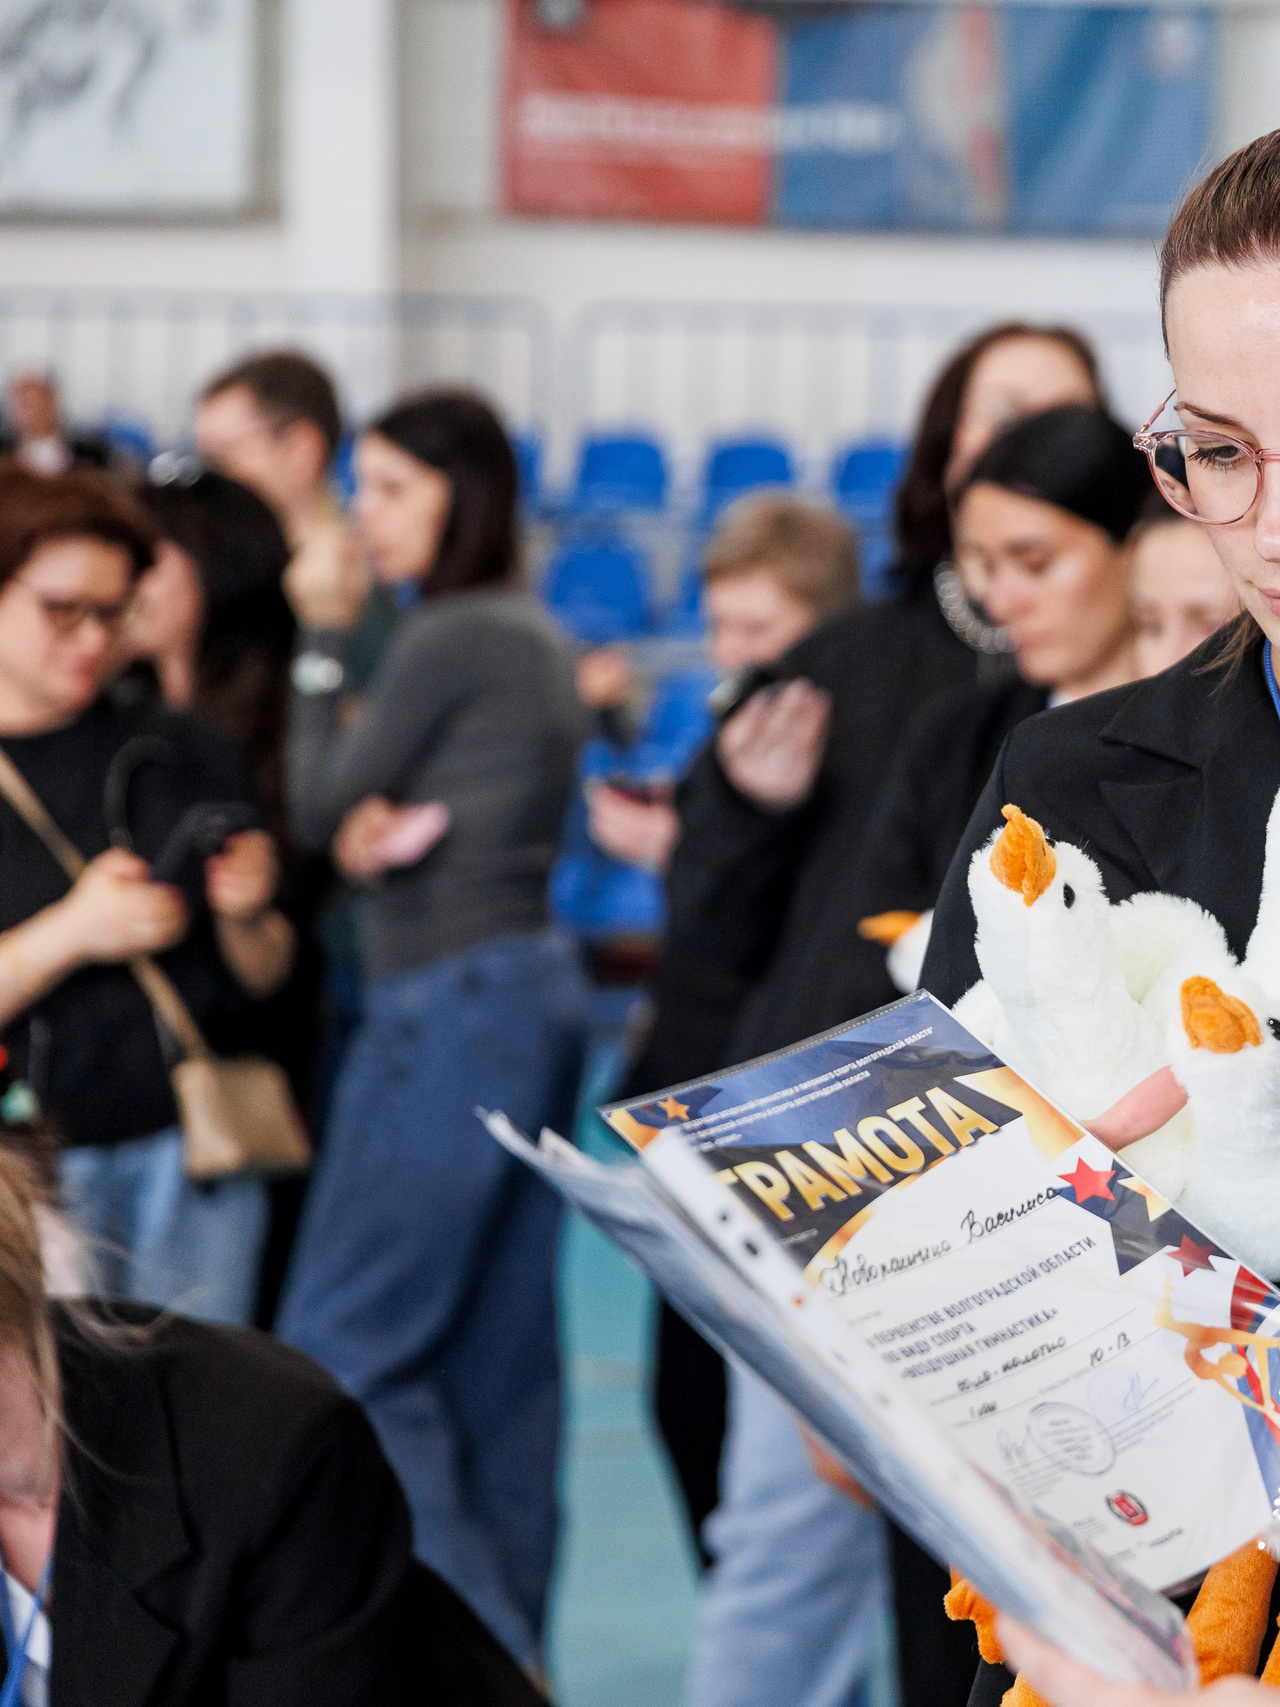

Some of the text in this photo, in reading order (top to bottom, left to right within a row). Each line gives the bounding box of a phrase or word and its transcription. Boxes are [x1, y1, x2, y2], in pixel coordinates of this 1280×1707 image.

[873, 1309, 946, 1346] ПЕРВЕНСТВЕ
[943, 1265, 1041, 1318] ВОЛГОГРАДСКОЙ
[1038, 1236, 1097, 1274] ОБЛАСТИ
[899, 1337, 932, 1361] ВИДУ
[930, 1320, 977, 1351] СПОРТА
